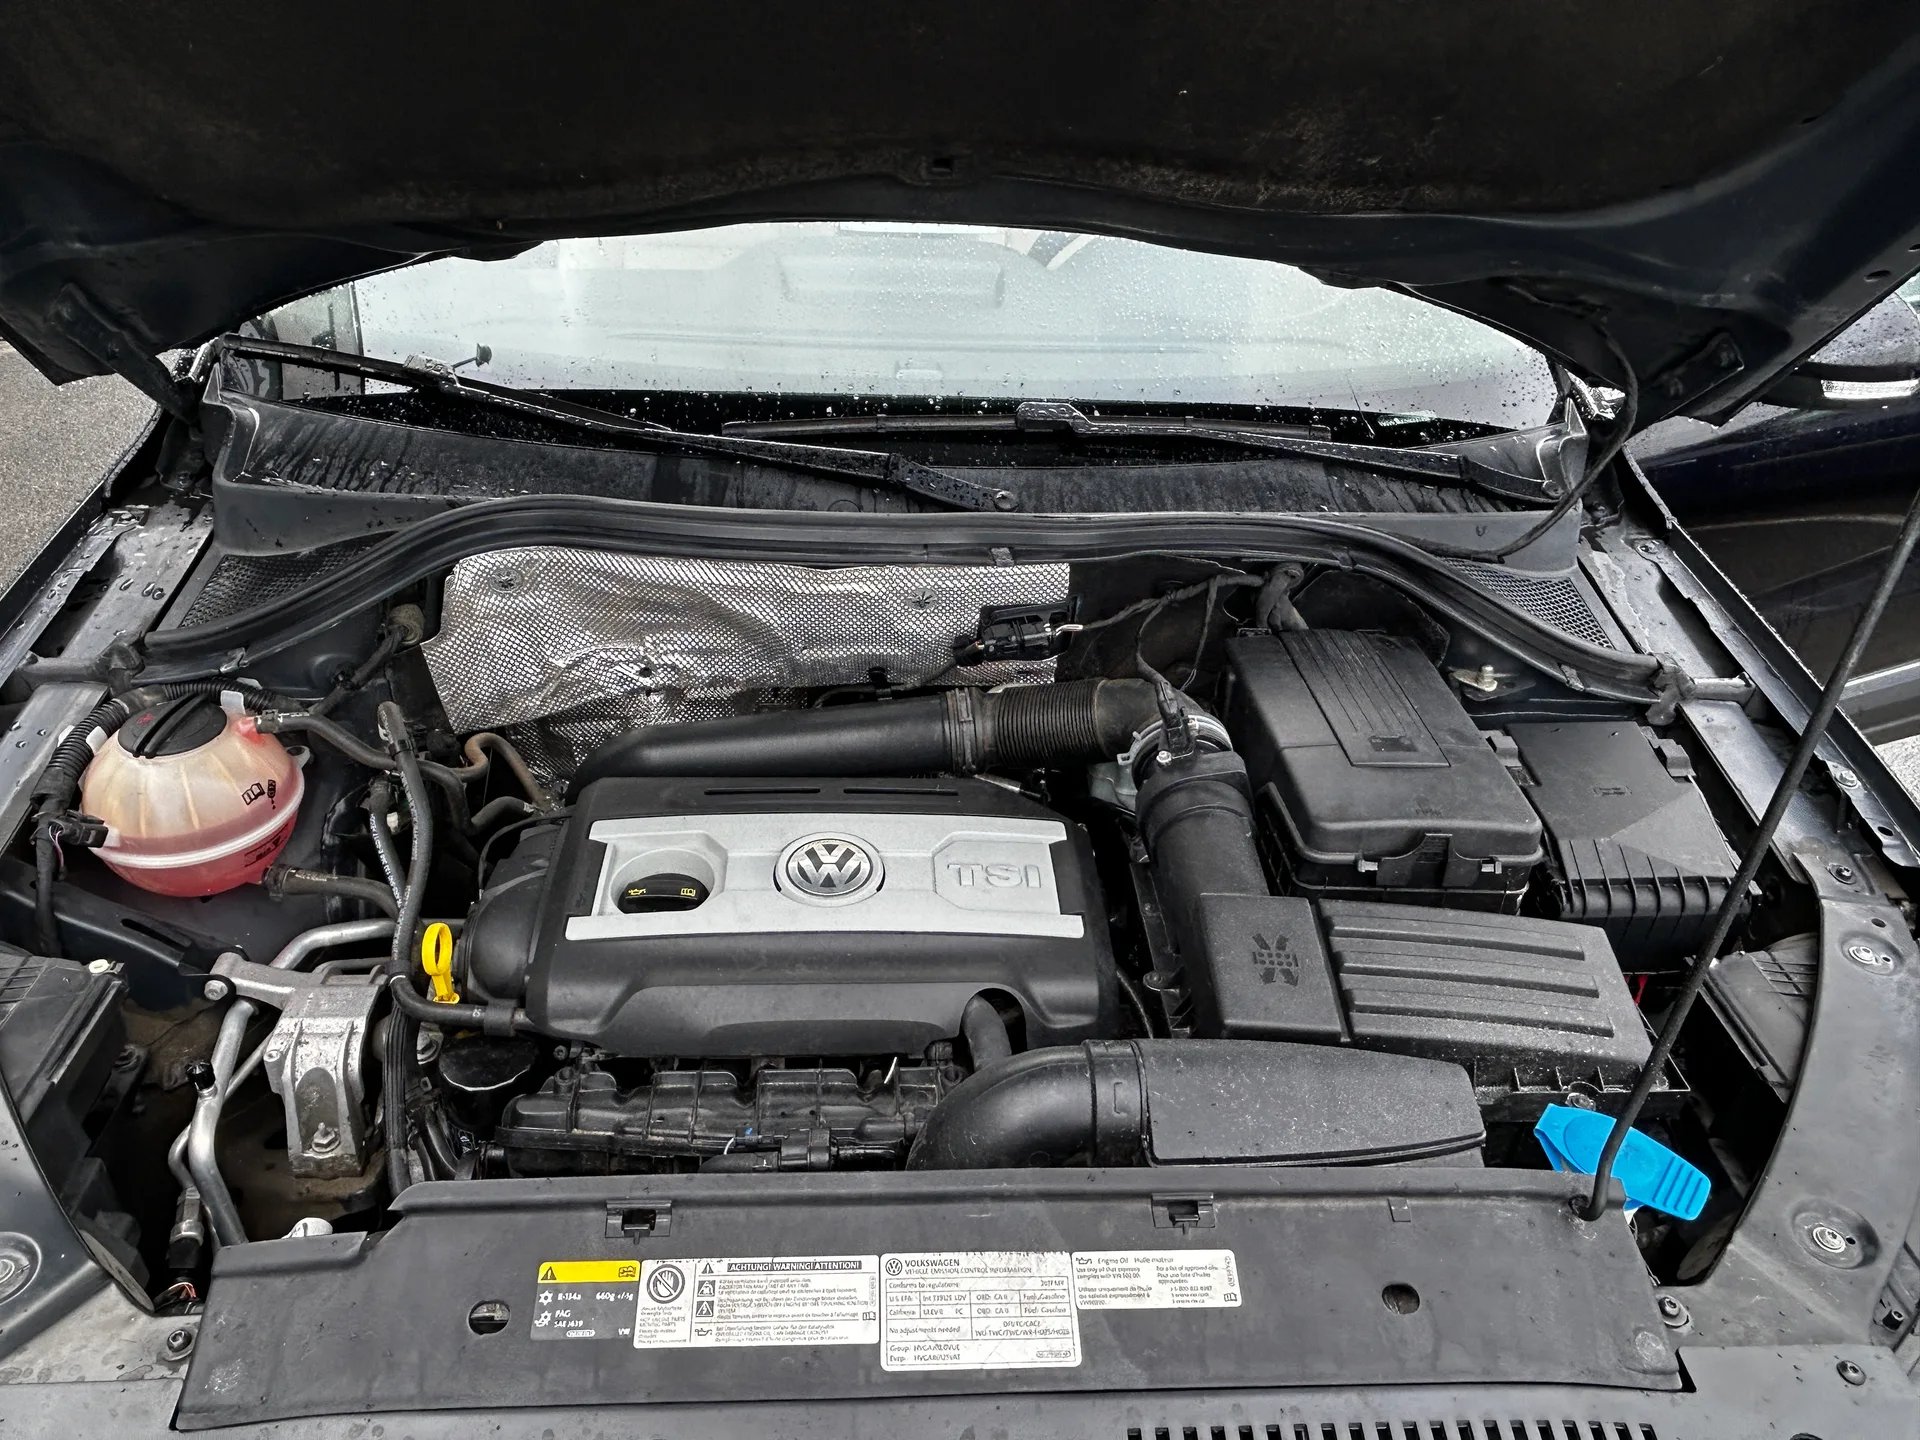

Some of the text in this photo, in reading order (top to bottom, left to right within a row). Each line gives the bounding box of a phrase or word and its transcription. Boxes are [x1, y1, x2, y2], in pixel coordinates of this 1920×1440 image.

[786, 838, 873, 897] VW
[947, 863, 1041, 888] TSI
[904, 1259, 960, 1267] VOLKSWAGEN
